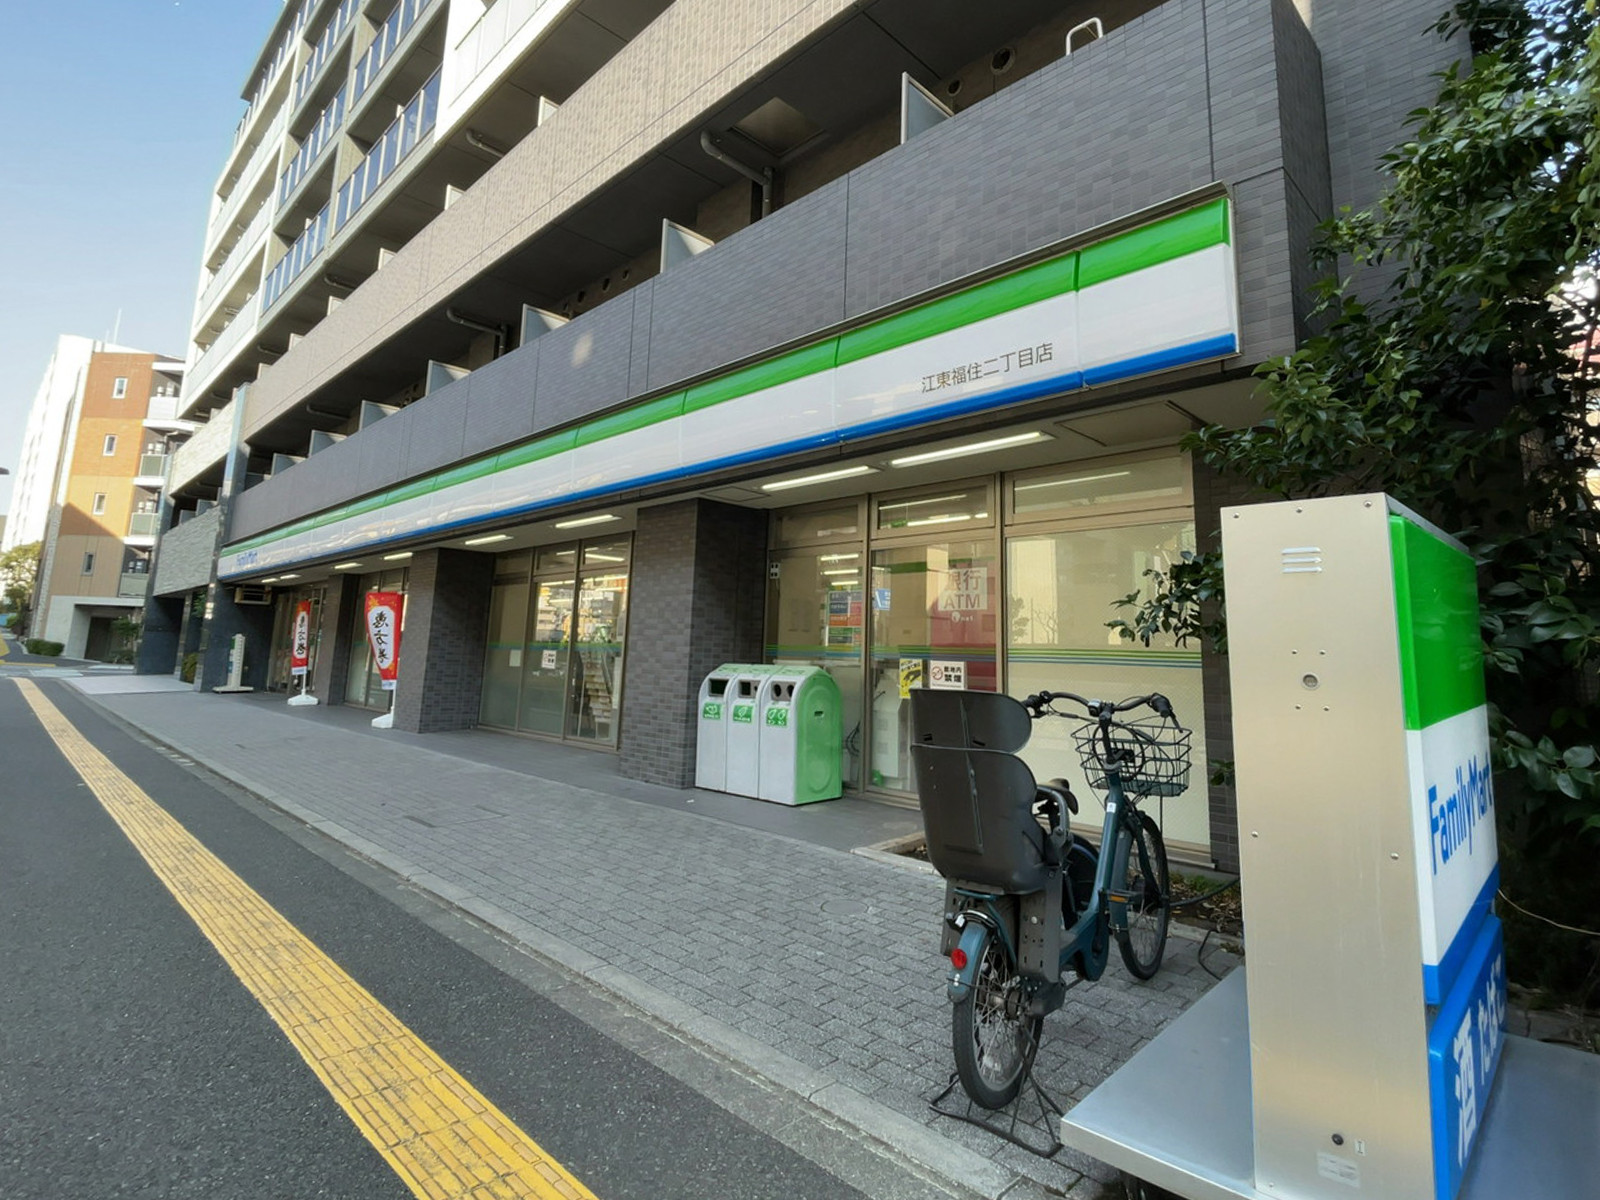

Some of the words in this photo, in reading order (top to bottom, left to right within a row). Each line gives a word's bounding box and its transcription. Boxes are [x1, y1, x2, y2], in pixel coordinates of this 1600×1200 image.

[921, 343, 1053, 393] 江東福住二丁目店
[944, 594, 980, 609] ATM
[1428, 751, 1493, 876] FamilyMart
[1453, 1007, 1478, 1168] 酒
